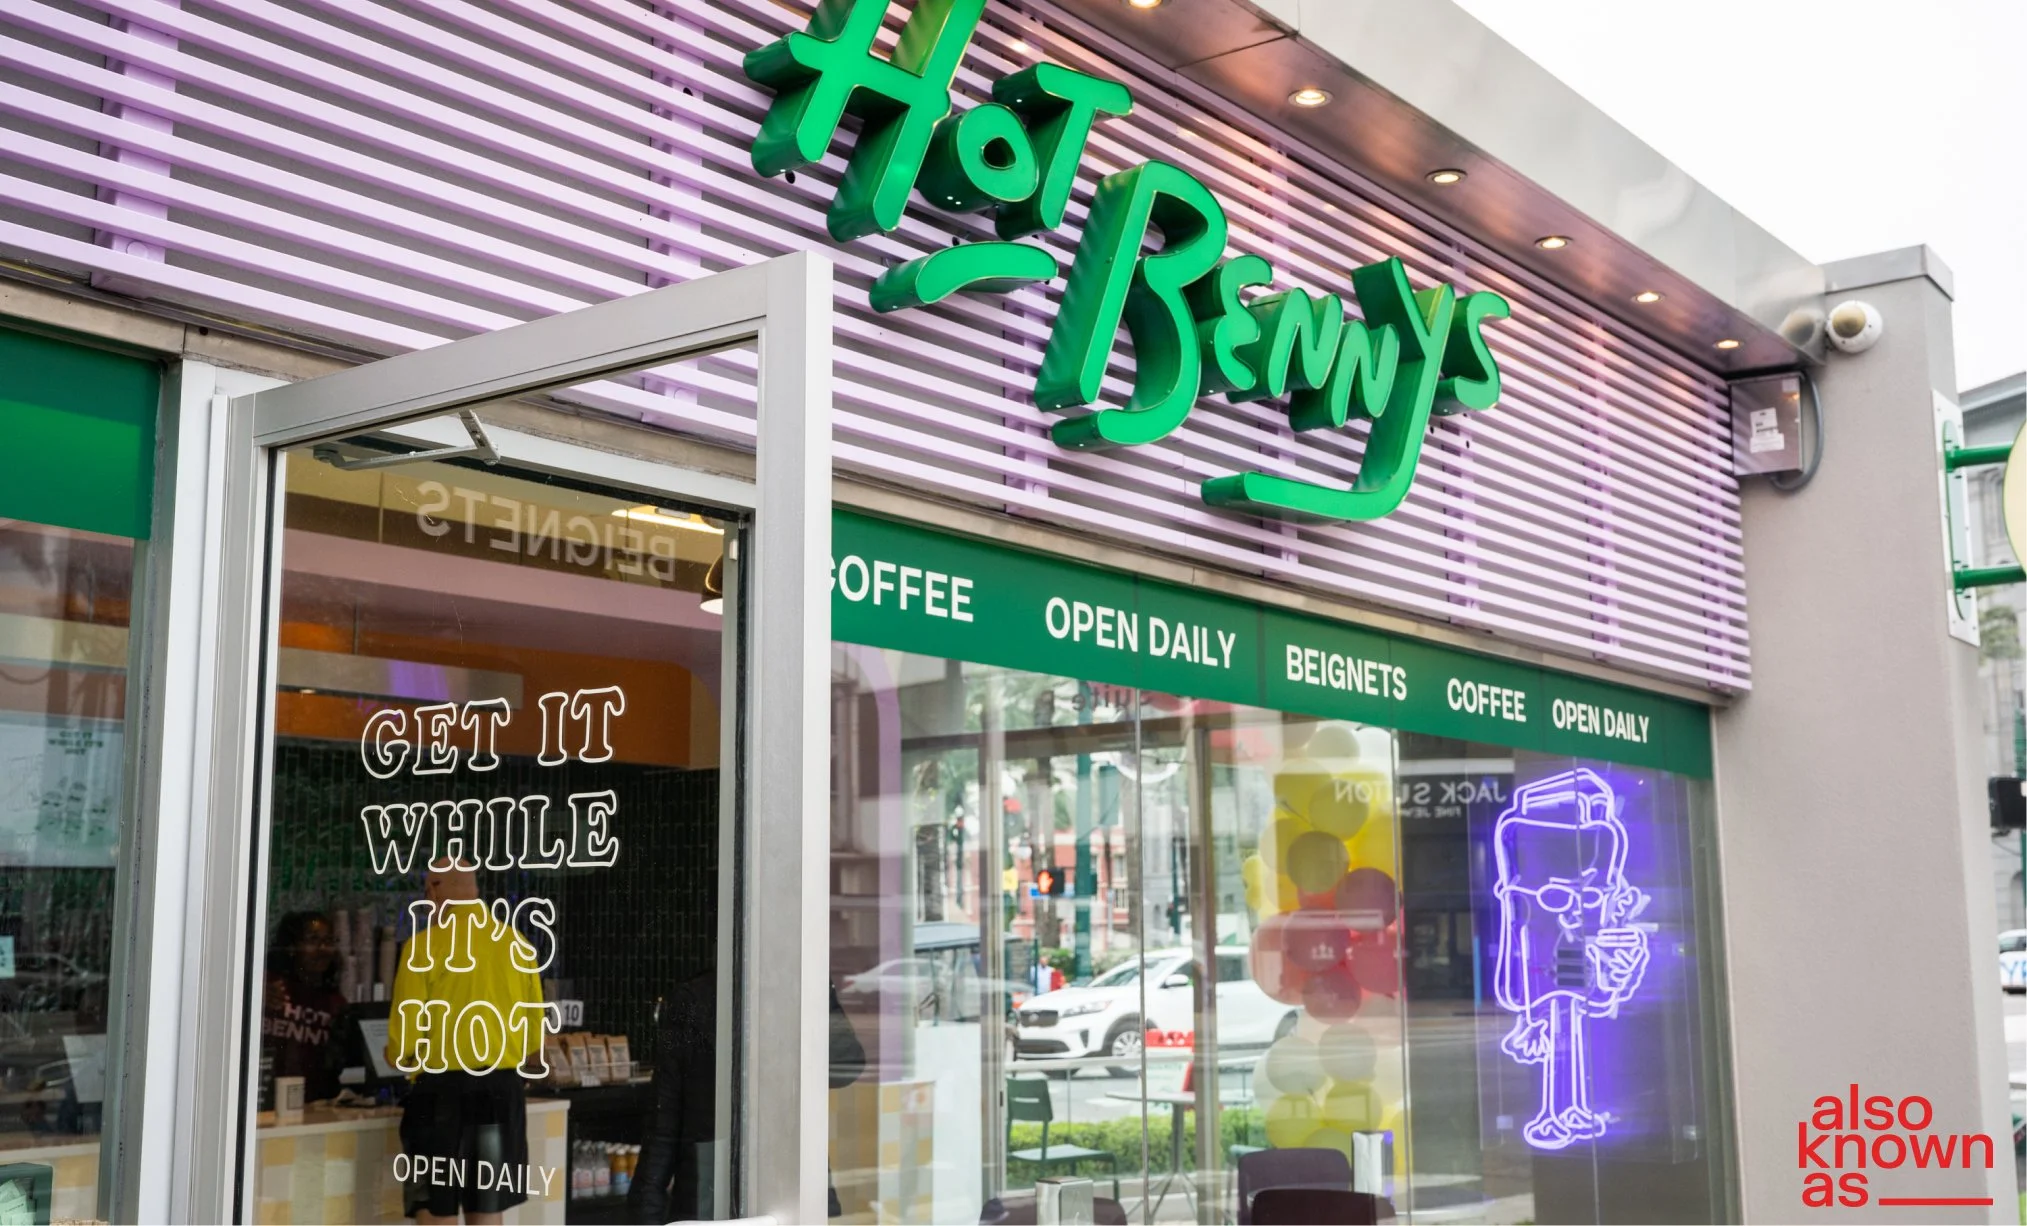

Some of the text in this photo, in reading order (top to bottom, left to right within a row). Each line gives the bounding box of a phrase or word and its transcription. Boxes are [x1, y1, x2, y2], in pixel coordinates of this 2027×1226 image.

[744, 0, 1133, 242] HOT
[831, 555, 1650, 744] OFFEE OPEN DAILY BEIGNETS COFFEE OPEN DAILY
[361, 685, 626, 779] GET IT
[361, 789, 620, 875] WHILE
[406, 897, 556, 974] IT'S
[395, 999, 561, 1079] HOT
[393, 1153, 467, 1188] OPEN
[476, 1160, 556, 1196] DAILY
